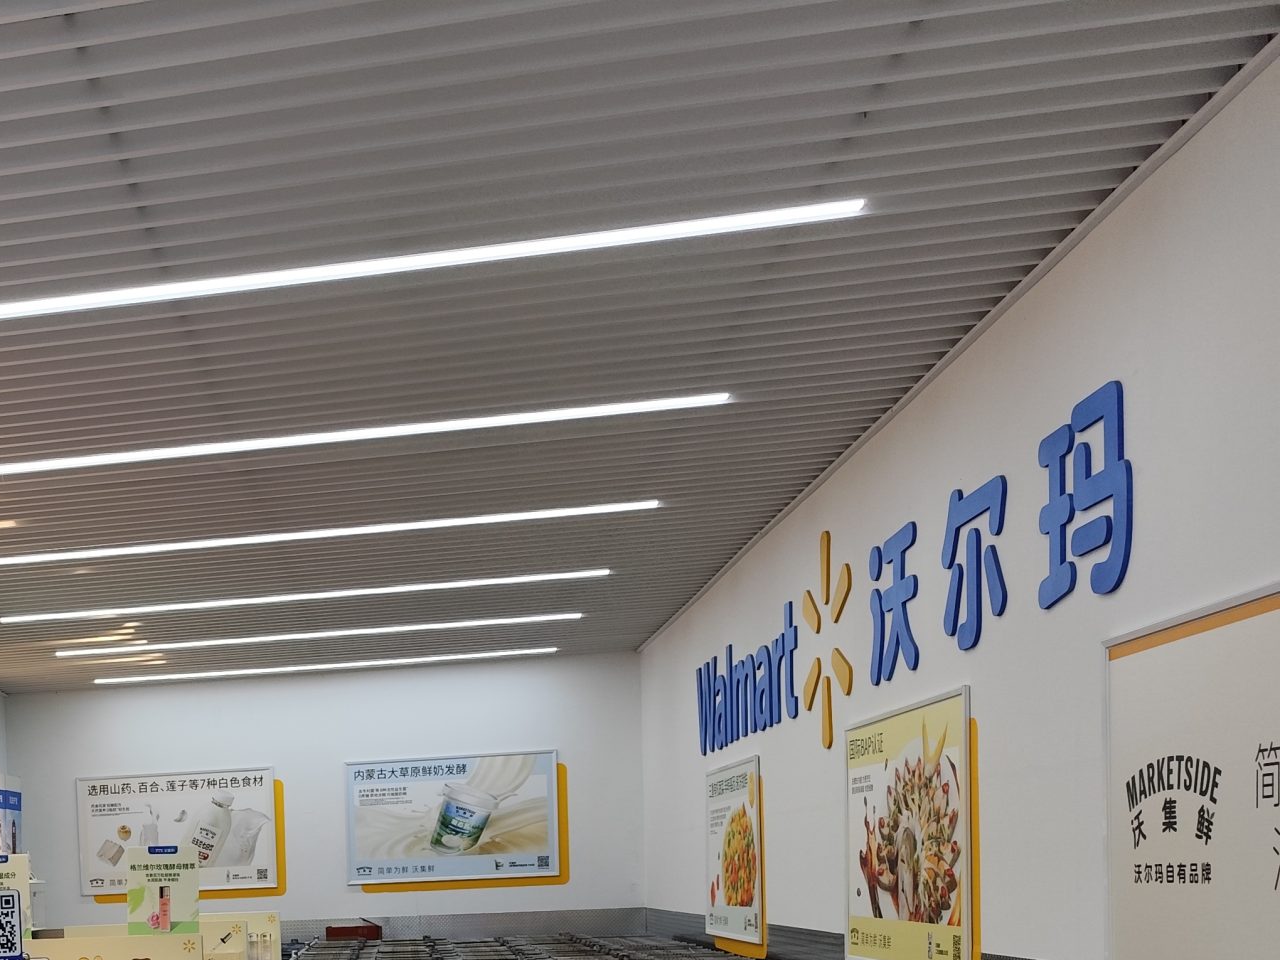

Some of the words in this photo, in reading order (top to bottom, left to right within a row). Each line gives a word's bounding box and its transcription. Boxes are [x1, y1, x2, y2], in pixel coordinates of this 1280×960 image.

[869, 380, 1133, 686] 沃尔玛
[696, 601, 798, 756] Walmart
[87, 774, 264, 797] 选用山药、百合、莲子等7种白色食材
[353, 763, 468, 781] 内蒙古大草原鲜奶发酵
[1125, 754, 1222, 812] MARKETSIDE
[1131, 797, 1215, 850] 沃集鲜
[1133, 861, 1212, 885] 沃尔玛自有品牌
